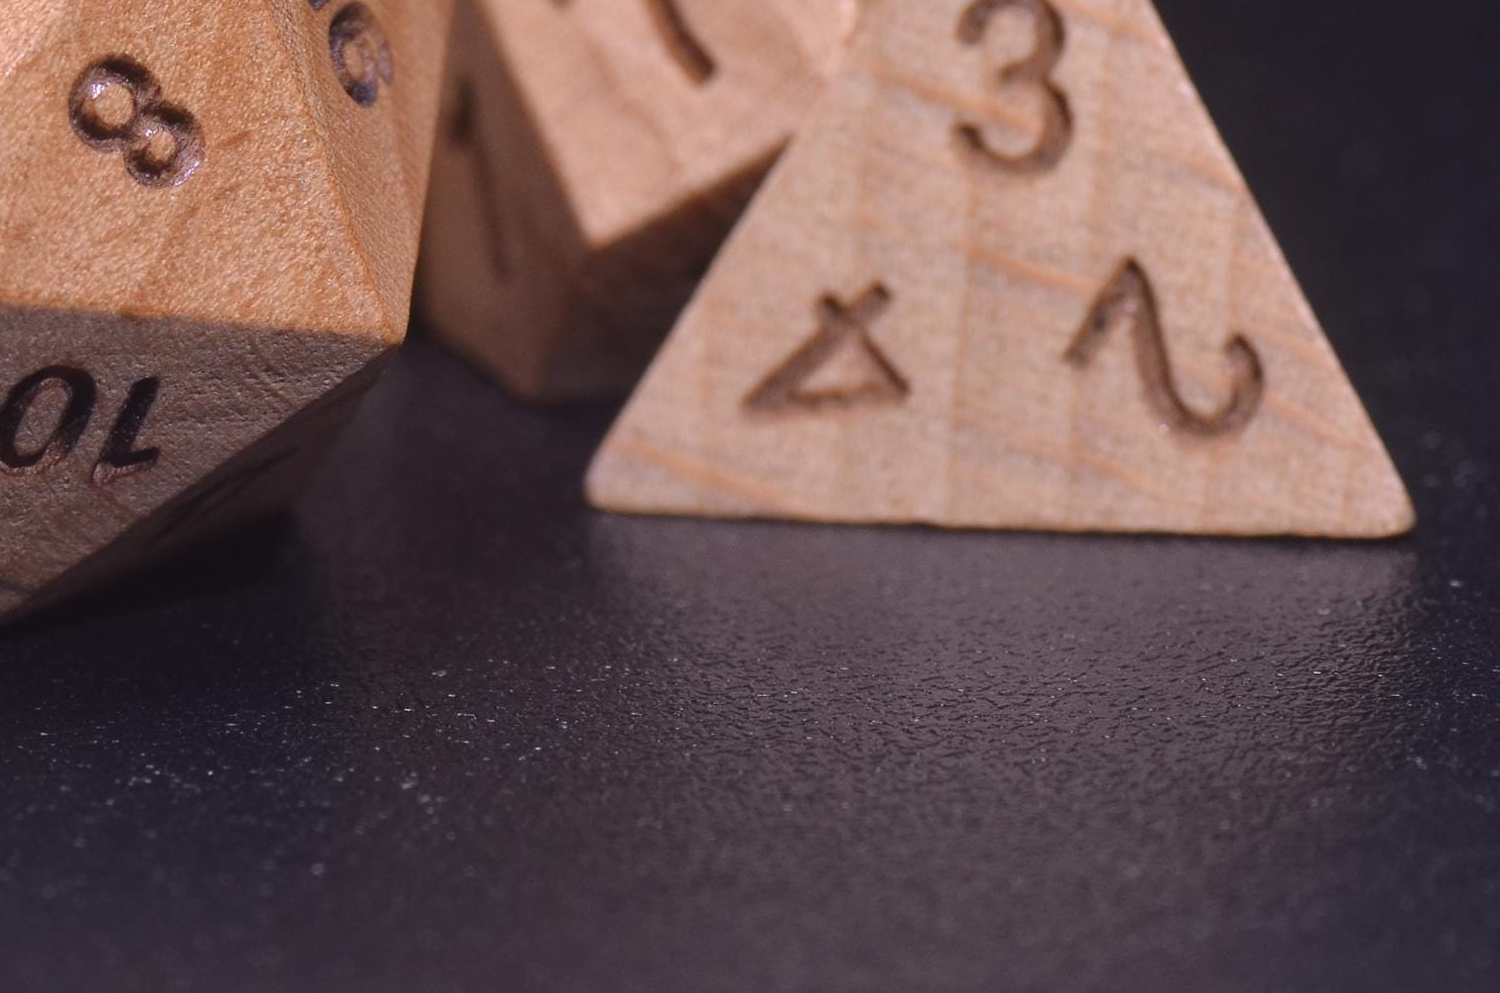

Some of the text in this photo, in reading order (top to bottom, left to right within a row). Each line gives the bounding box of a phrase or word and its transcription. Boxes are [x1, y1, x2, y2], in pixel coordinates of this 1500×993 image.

[68, 54, 206, 190] 8
[740, 280, 912, 420] 4
[1063, 256, 1266, 448] 2
